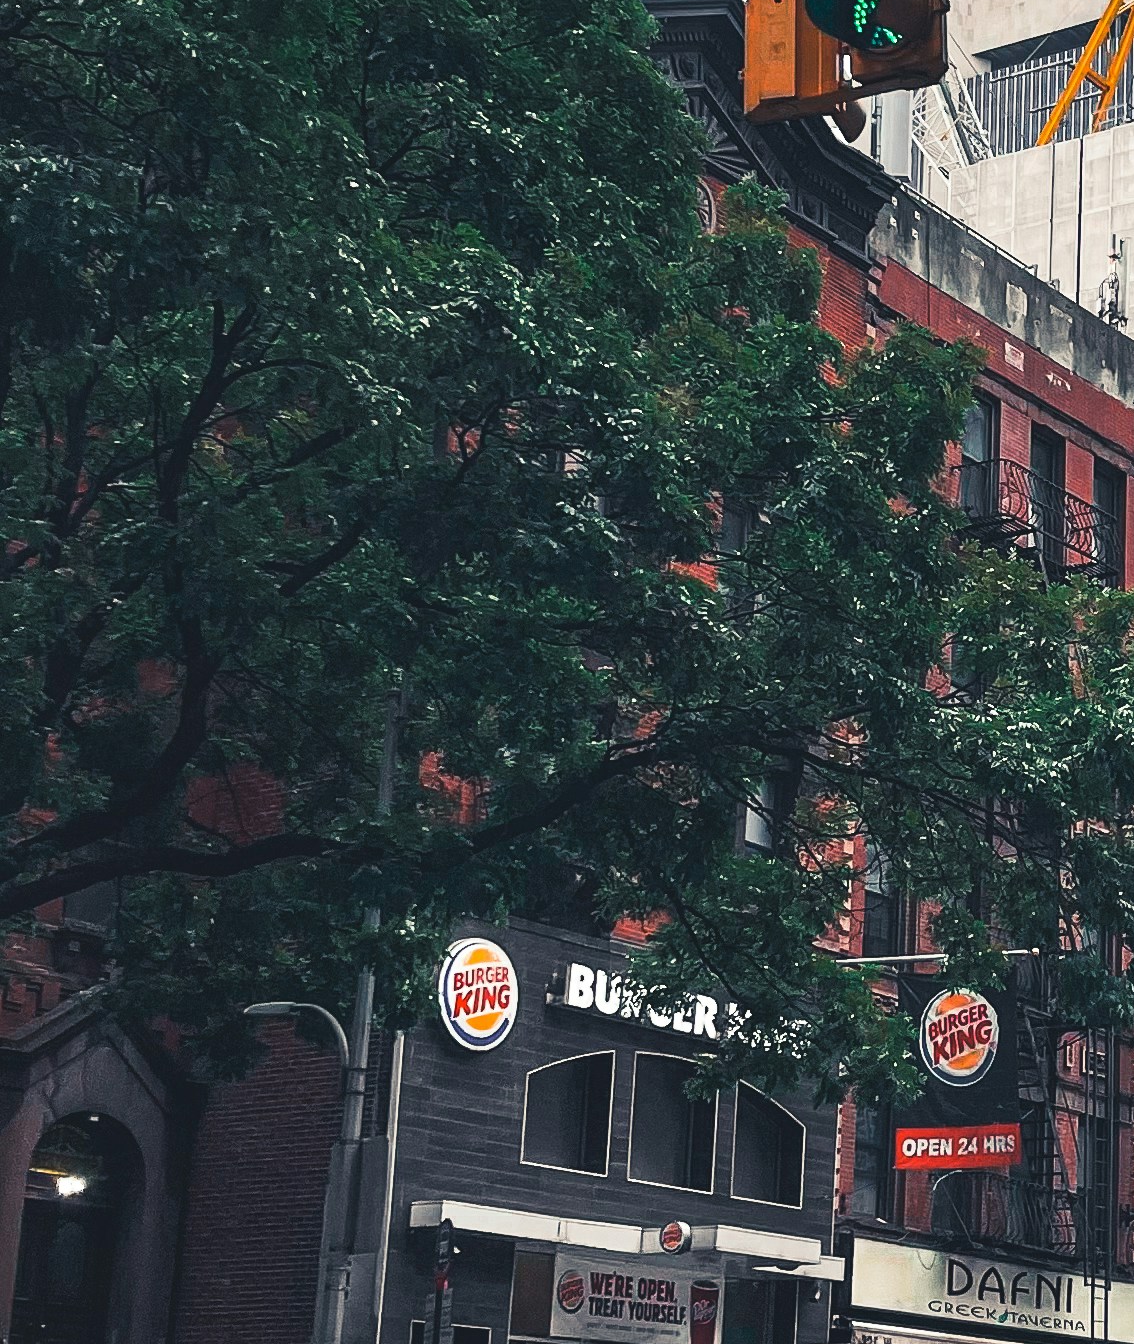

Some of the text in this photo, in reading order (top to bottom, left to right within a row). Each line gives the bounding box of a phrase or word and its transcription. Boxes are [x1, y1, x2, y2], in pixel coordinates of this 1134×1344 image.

[453, 966, 510, 992] BURGER
[452, 984, 511, 1019] KING
[928, 1003, 988, 1042] BURGER
[932, 1019, 993, 1066] KING
[902, 1134, 1015, 1157] OPEN 24 HRS
[589, 1270, 634, 1298] WE'RE
[946, 1258, 1074, 1313] DAFNI
[588, 1296, 626, 1319] TREAT
[927, 1300, 1086, 1332] GREEK TAVERNA
